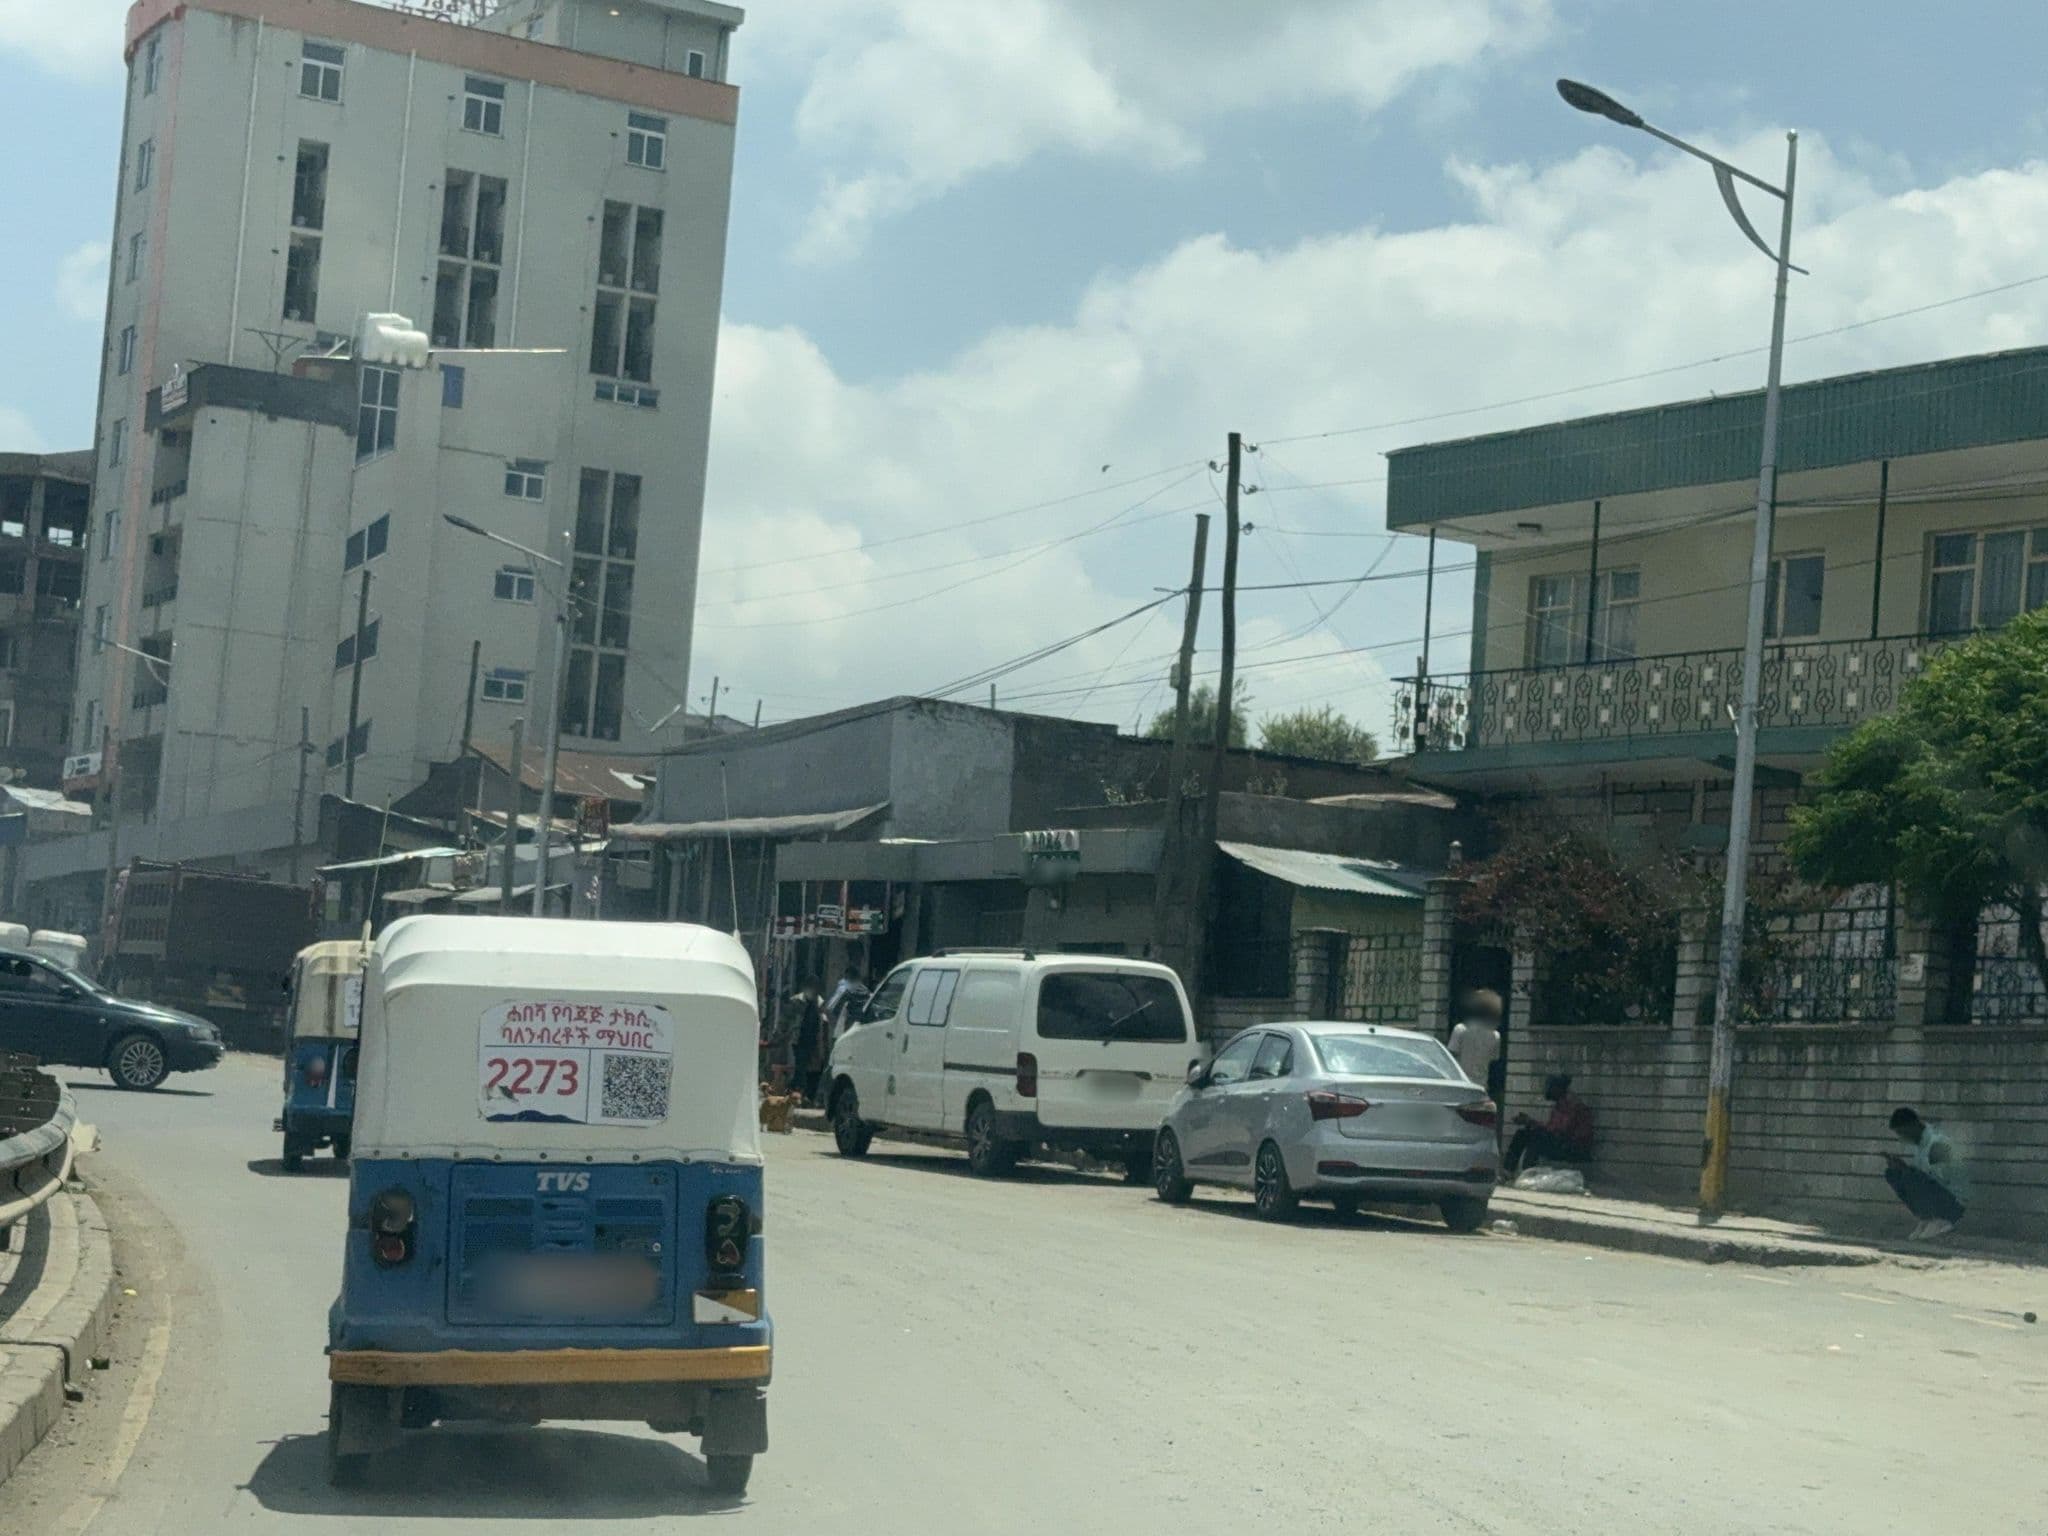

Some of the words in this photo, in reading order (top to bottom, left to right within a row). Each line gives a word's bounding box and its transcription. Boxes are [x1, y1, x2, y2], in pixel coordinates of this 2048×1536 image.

[608, 1008, 650, 1028] ታክሲ
[596, 1029, 654, 1049] ማህበር
[486, 1057, 579, 1096] 2273
[537, 1172, 590, 1191] TVS
